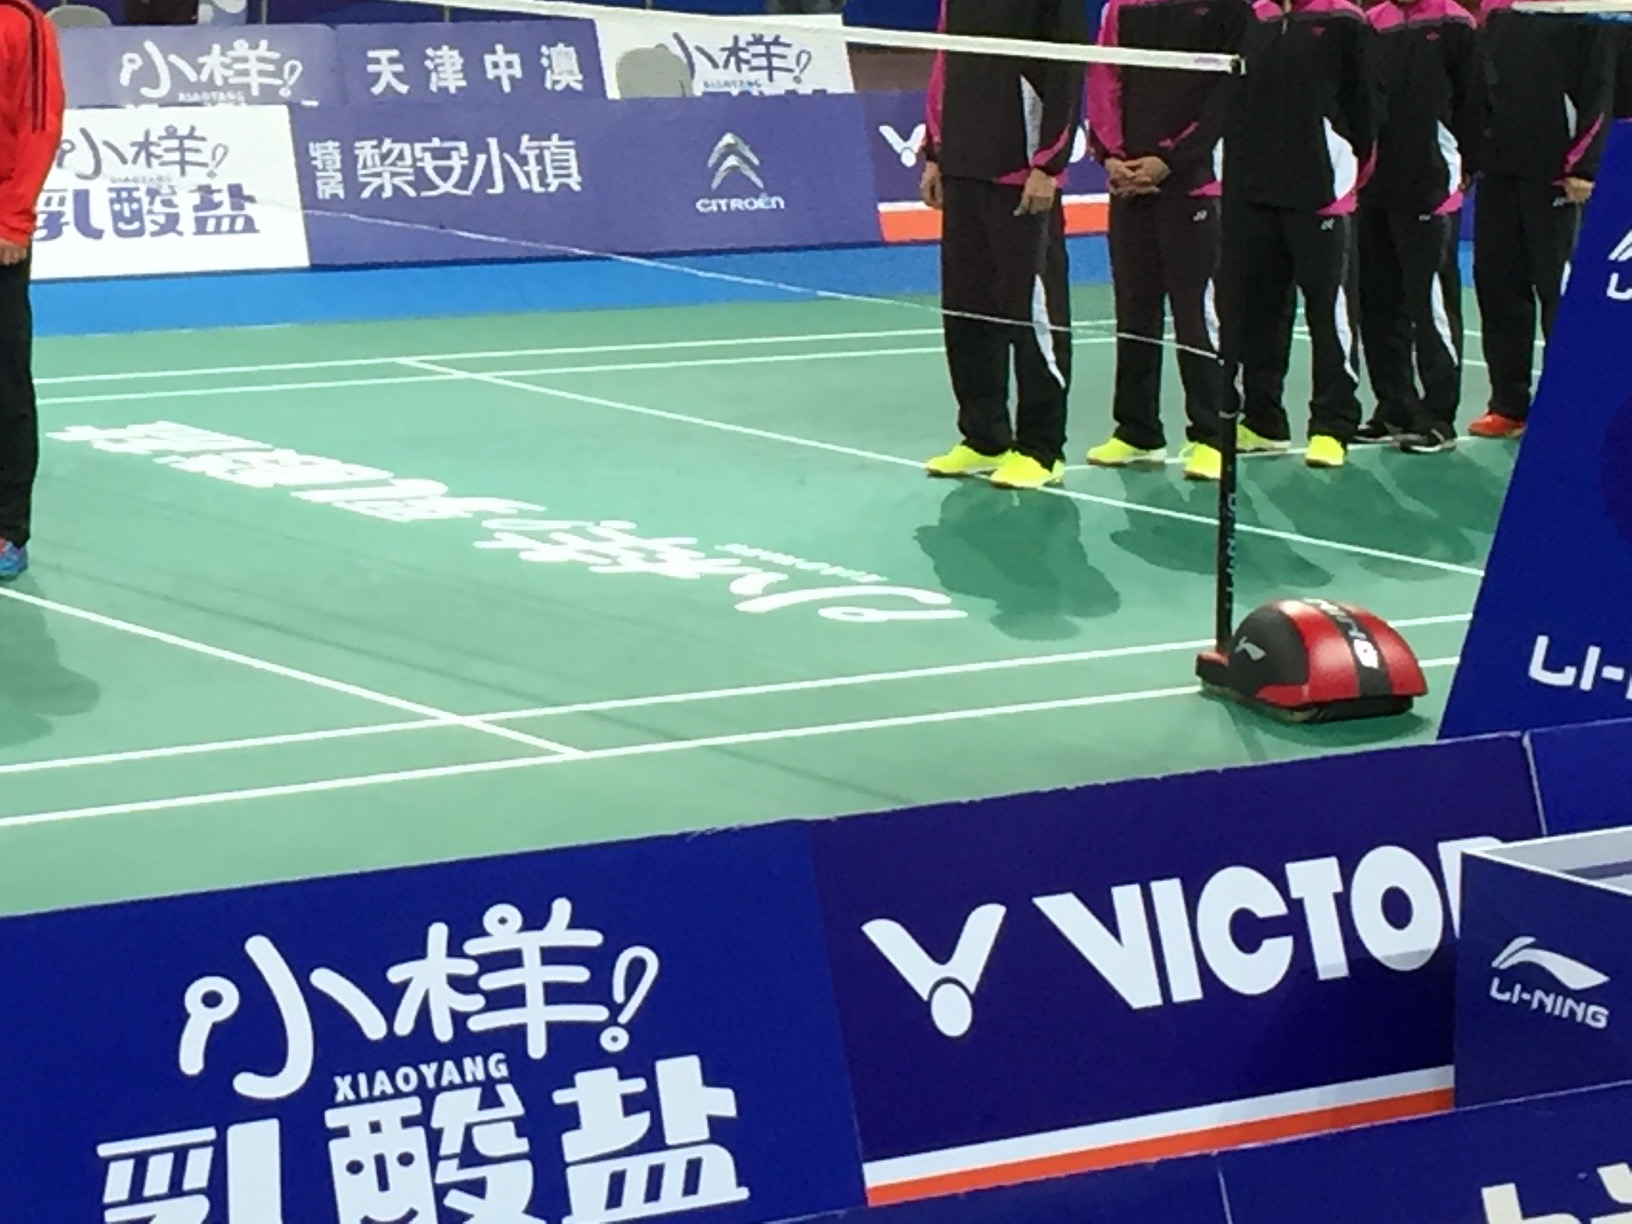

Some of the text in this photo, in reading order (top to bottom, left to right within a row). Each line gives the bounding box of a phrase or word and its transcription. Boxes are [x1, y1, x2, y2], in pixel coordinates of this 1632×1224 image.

[366, 46, 584, 96] 天津中澳
[354, 135, 582, 200] 黎安小镇
[32, 183, 260, 242] 乳酸盐
[1489, 978, 1610, 1029] LI-NING
[334, 1052, 510, 1103] XIAOYANG
[96, 1054, 751, 1224] 乳酸盐
